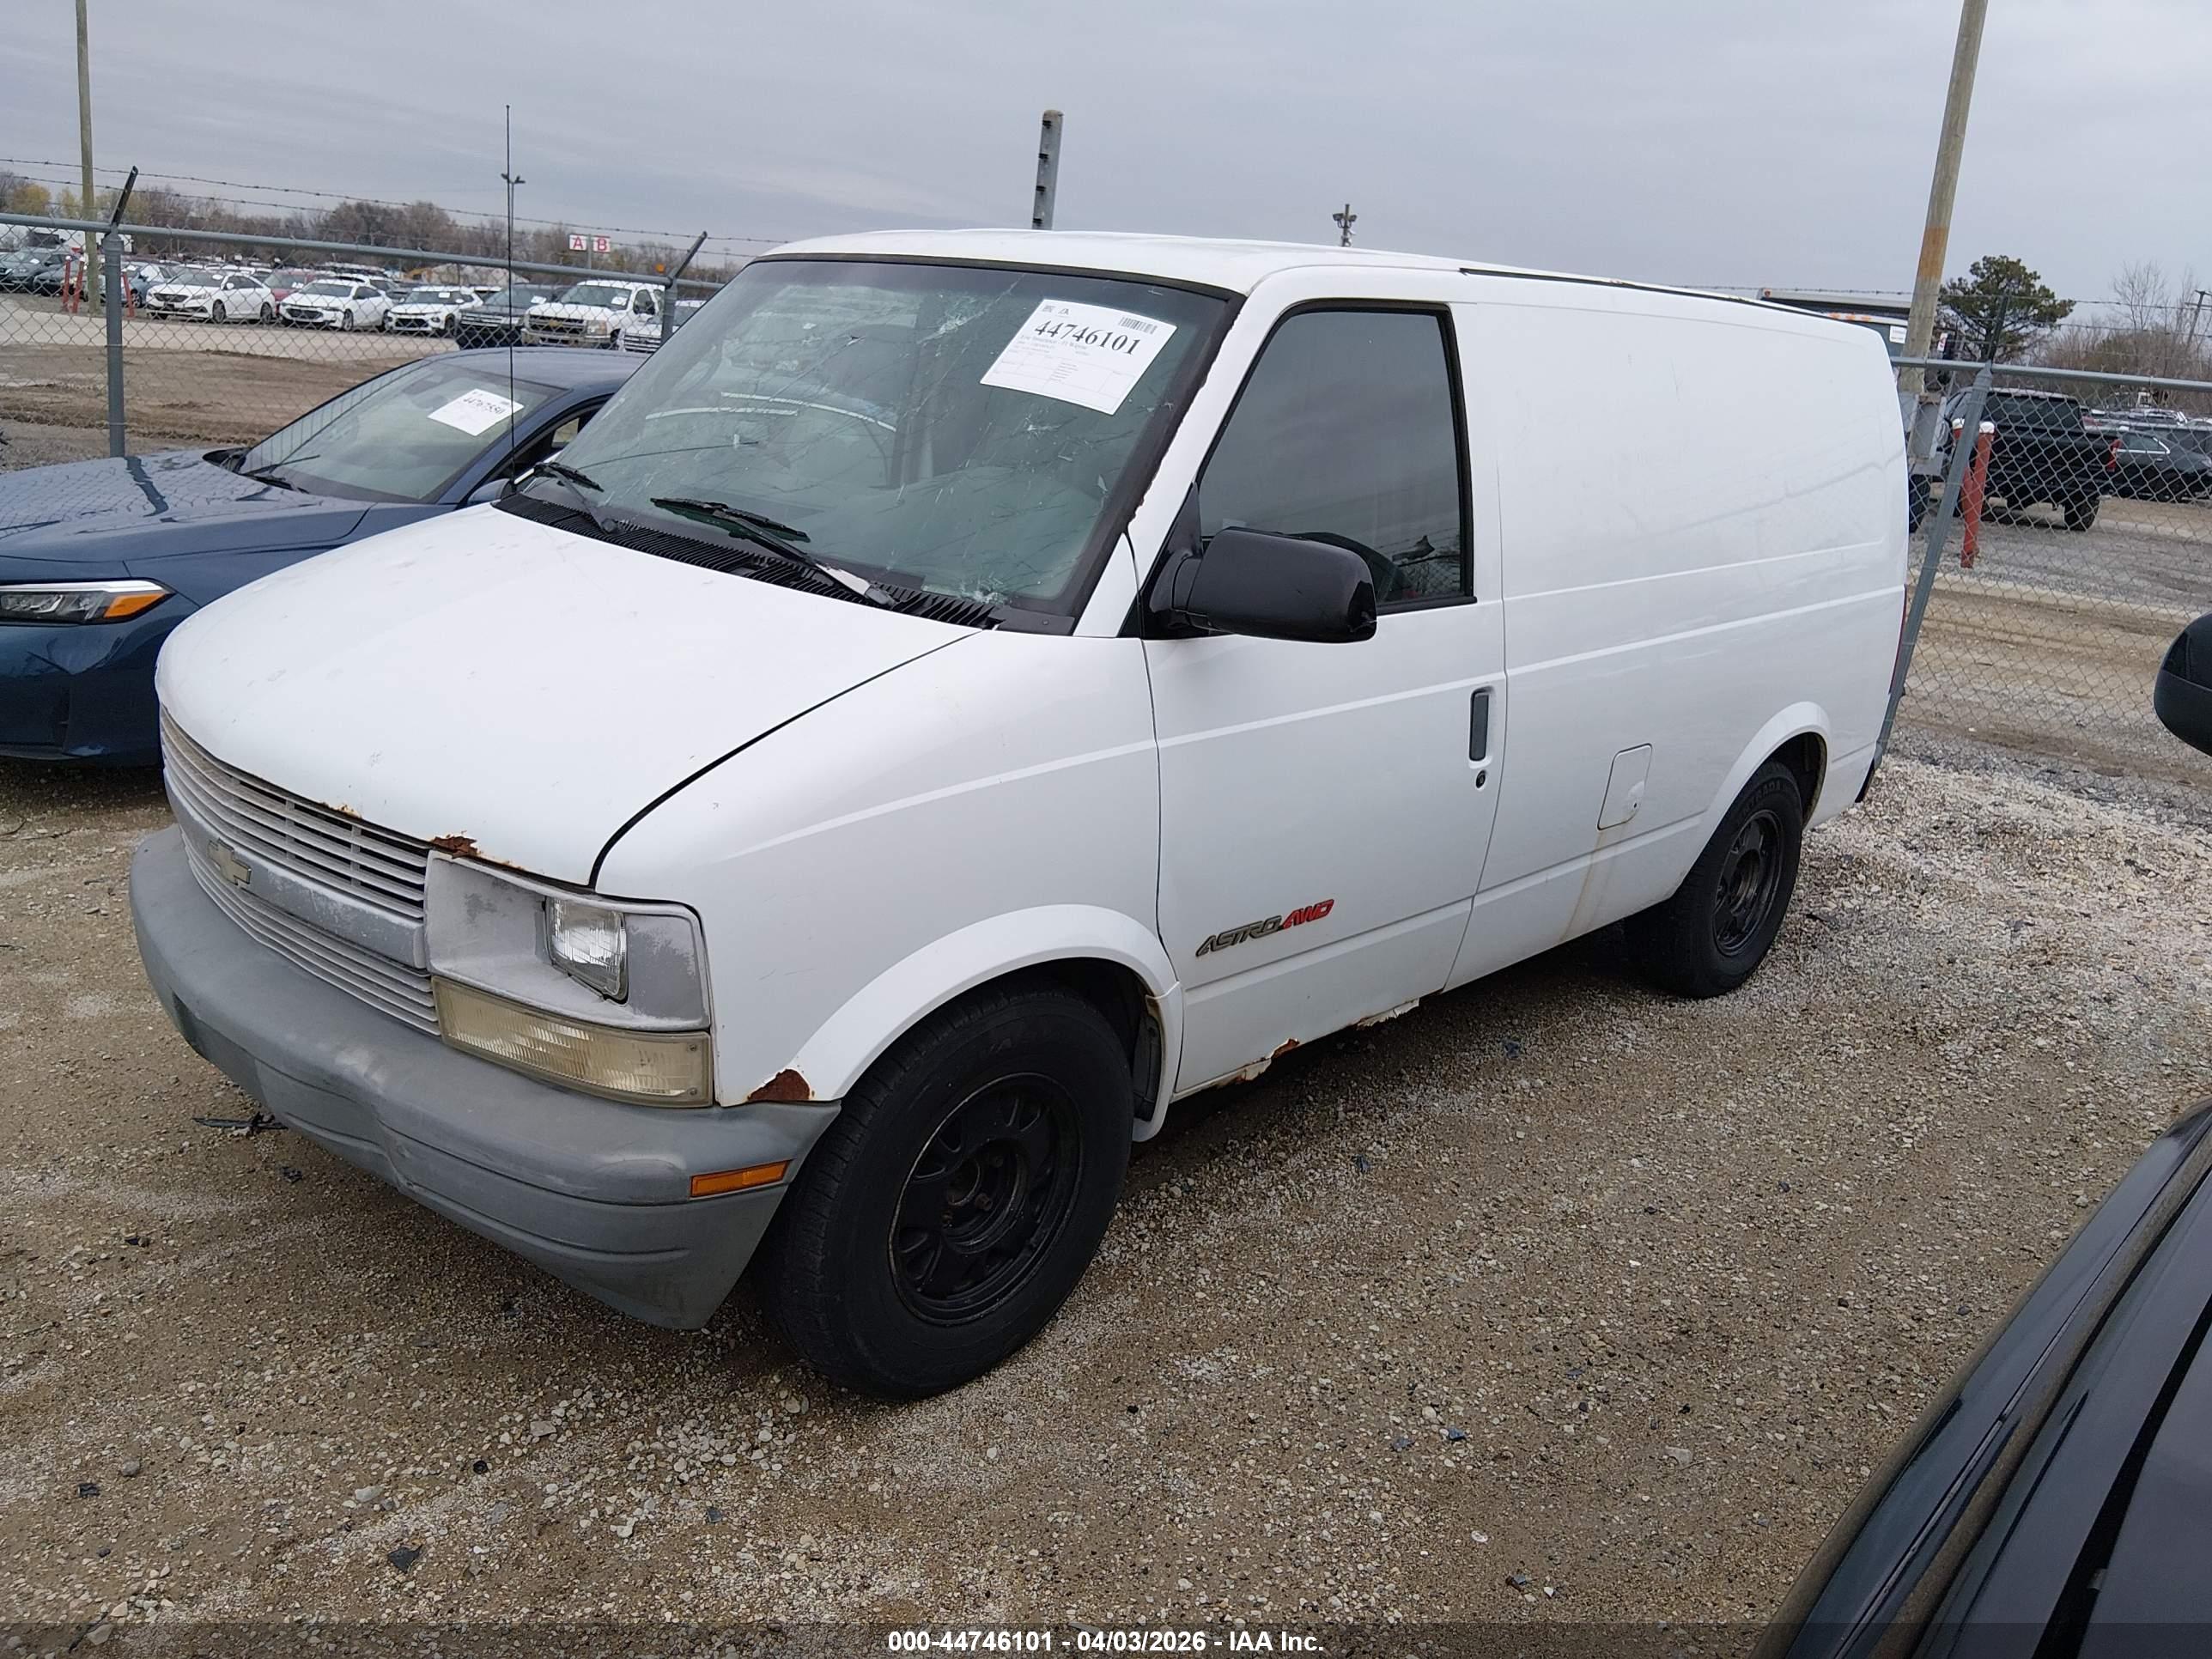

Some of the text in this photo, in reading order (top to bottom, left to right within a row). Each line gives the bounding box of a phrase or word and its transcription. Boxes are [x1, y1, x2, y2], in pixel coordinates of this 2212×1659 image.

[573, 236, 608, 252] A B
[1034, 319, 1141, 356] 44746101
[1195, 898, 1335, 957] ASTRO AWD
